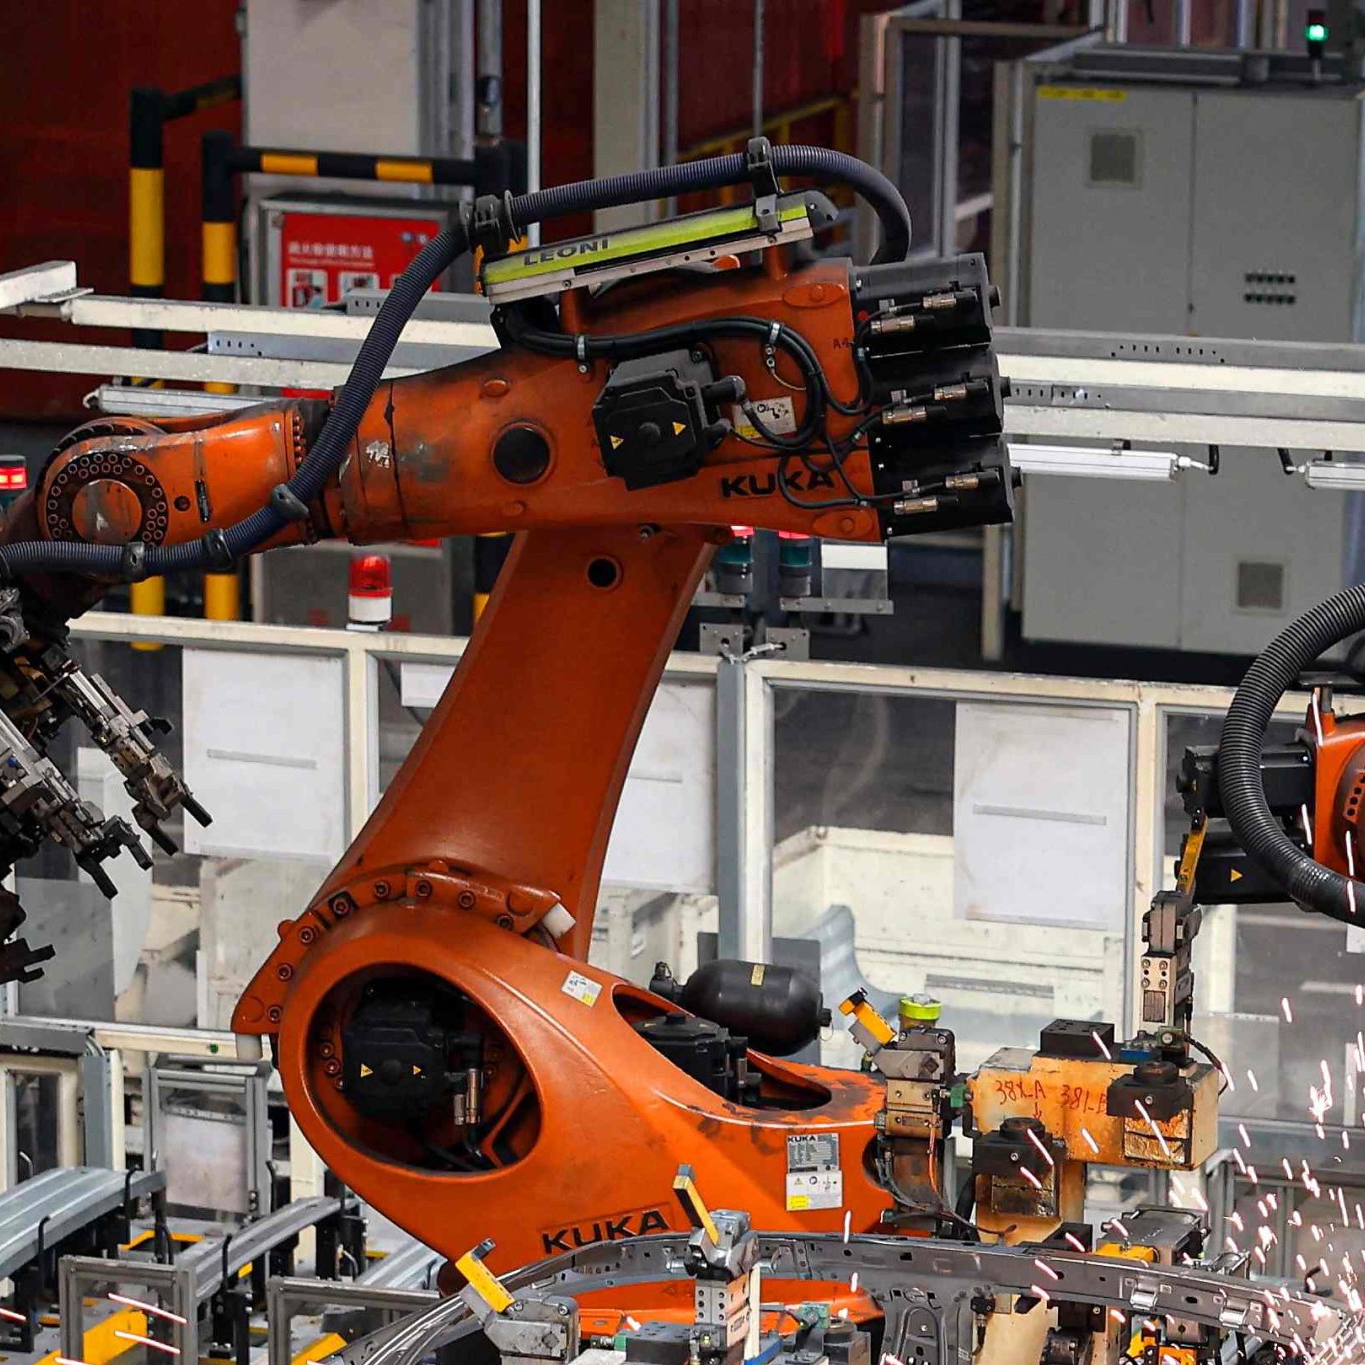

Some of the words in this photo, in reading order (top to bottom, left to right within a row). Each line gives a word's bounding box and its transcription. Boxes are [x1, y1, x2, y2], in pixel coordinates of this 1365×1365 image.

[523, 239, 609, 266] LEONI
[721, 470, 834, 498] KUKA
[788, 1134, 816, 1143] KUKA
[542, 1208, 669, 1254] KUKA
